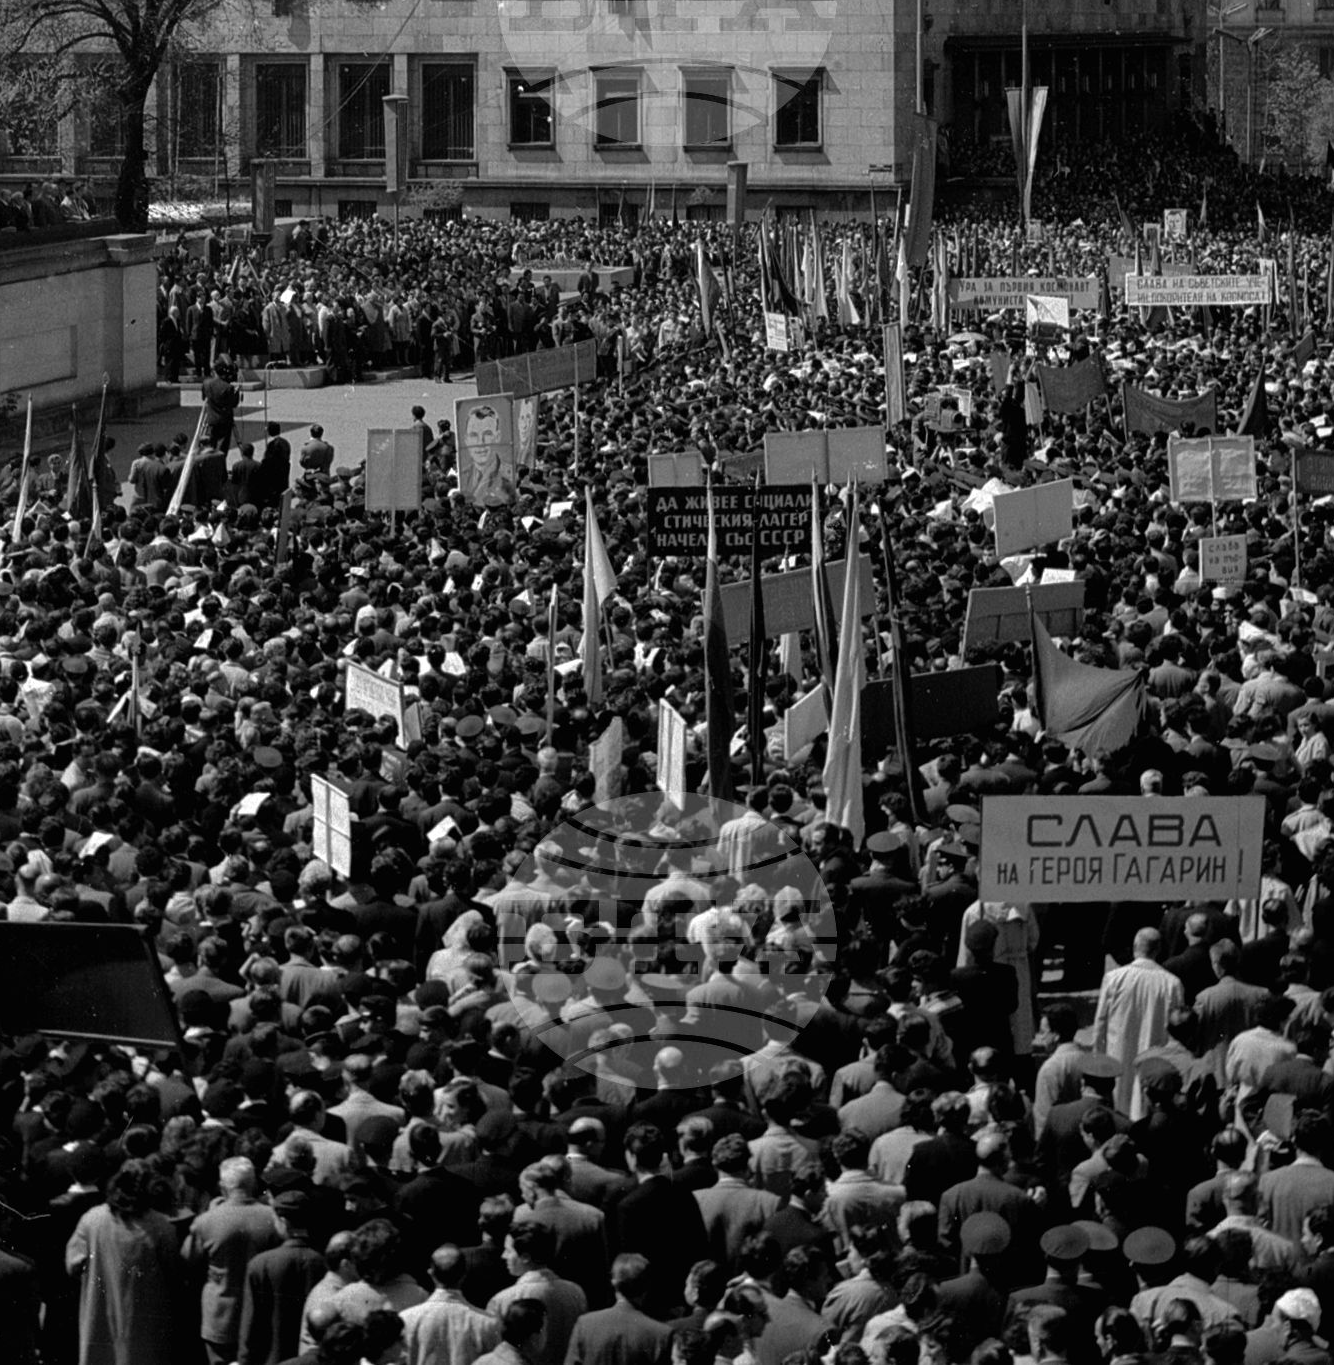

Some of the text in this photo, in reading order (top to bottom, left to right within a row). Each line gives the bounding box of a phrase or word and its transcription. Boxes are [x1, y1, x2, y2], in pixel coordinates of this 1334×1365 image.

[959, 281, 1090, 293] УРА ЗА ПЪРВИЯ КОСМОНАВТ
[1137, 277, 1168, 289] СЛАВА
[1172, 277, 1184, 289] НА
[1206, 291, 1217, 303] НА
[655, 496, 679, 513] ДА
[663, 512, 809, 529] СТИЧЕСКИЯ ЛАГЕР
[656, 529, 805, 548] НАЧЕЛ СЪС СССР
[1027, 813, 1222, 848] СЛАВА
[997, 862, 1019, 885] НА
[1029, 856, 1103, 885] ГЕРОЯ
